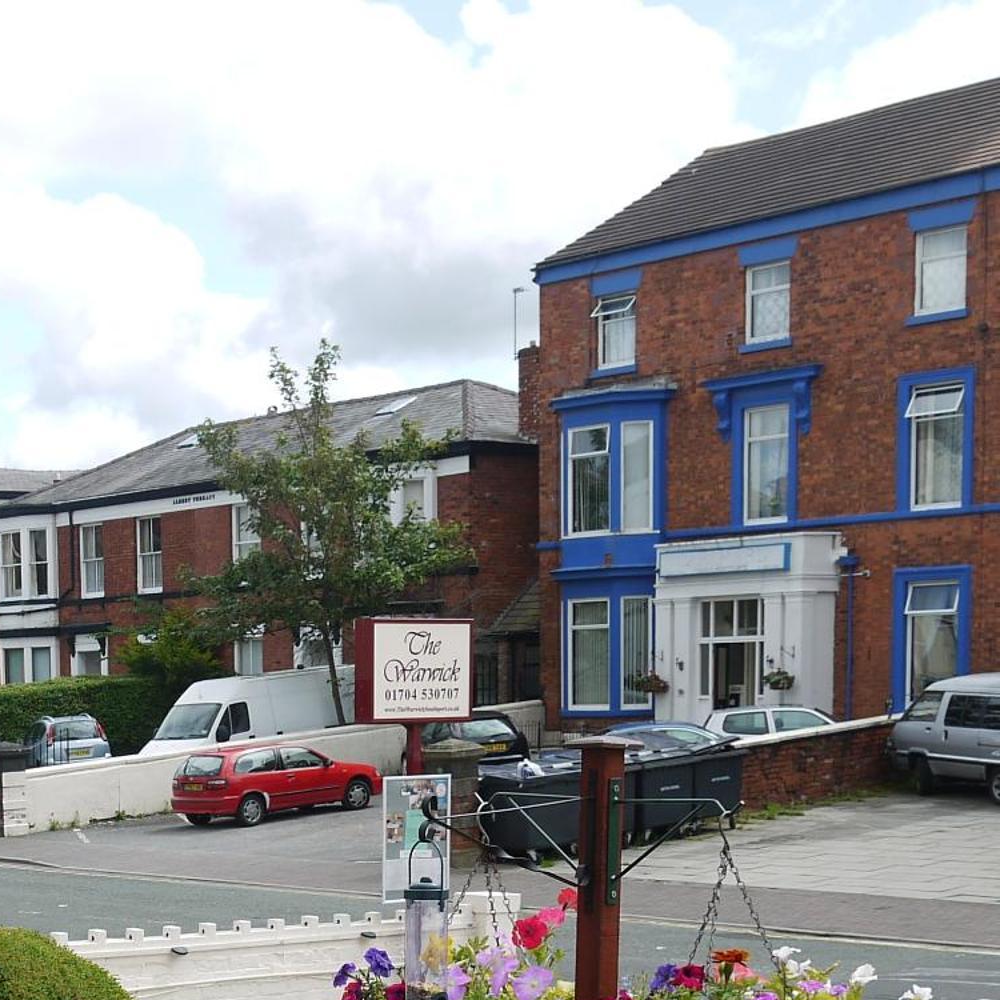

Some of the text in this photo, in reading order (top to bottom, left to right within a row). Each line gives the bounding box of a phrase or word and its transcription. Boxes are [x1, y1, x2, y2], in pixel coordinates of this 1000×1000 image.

[404, 631, 442, 655] The
[383, 658, 461, 682] Warwick
[384, 688, 459, 701] 01704 530707
